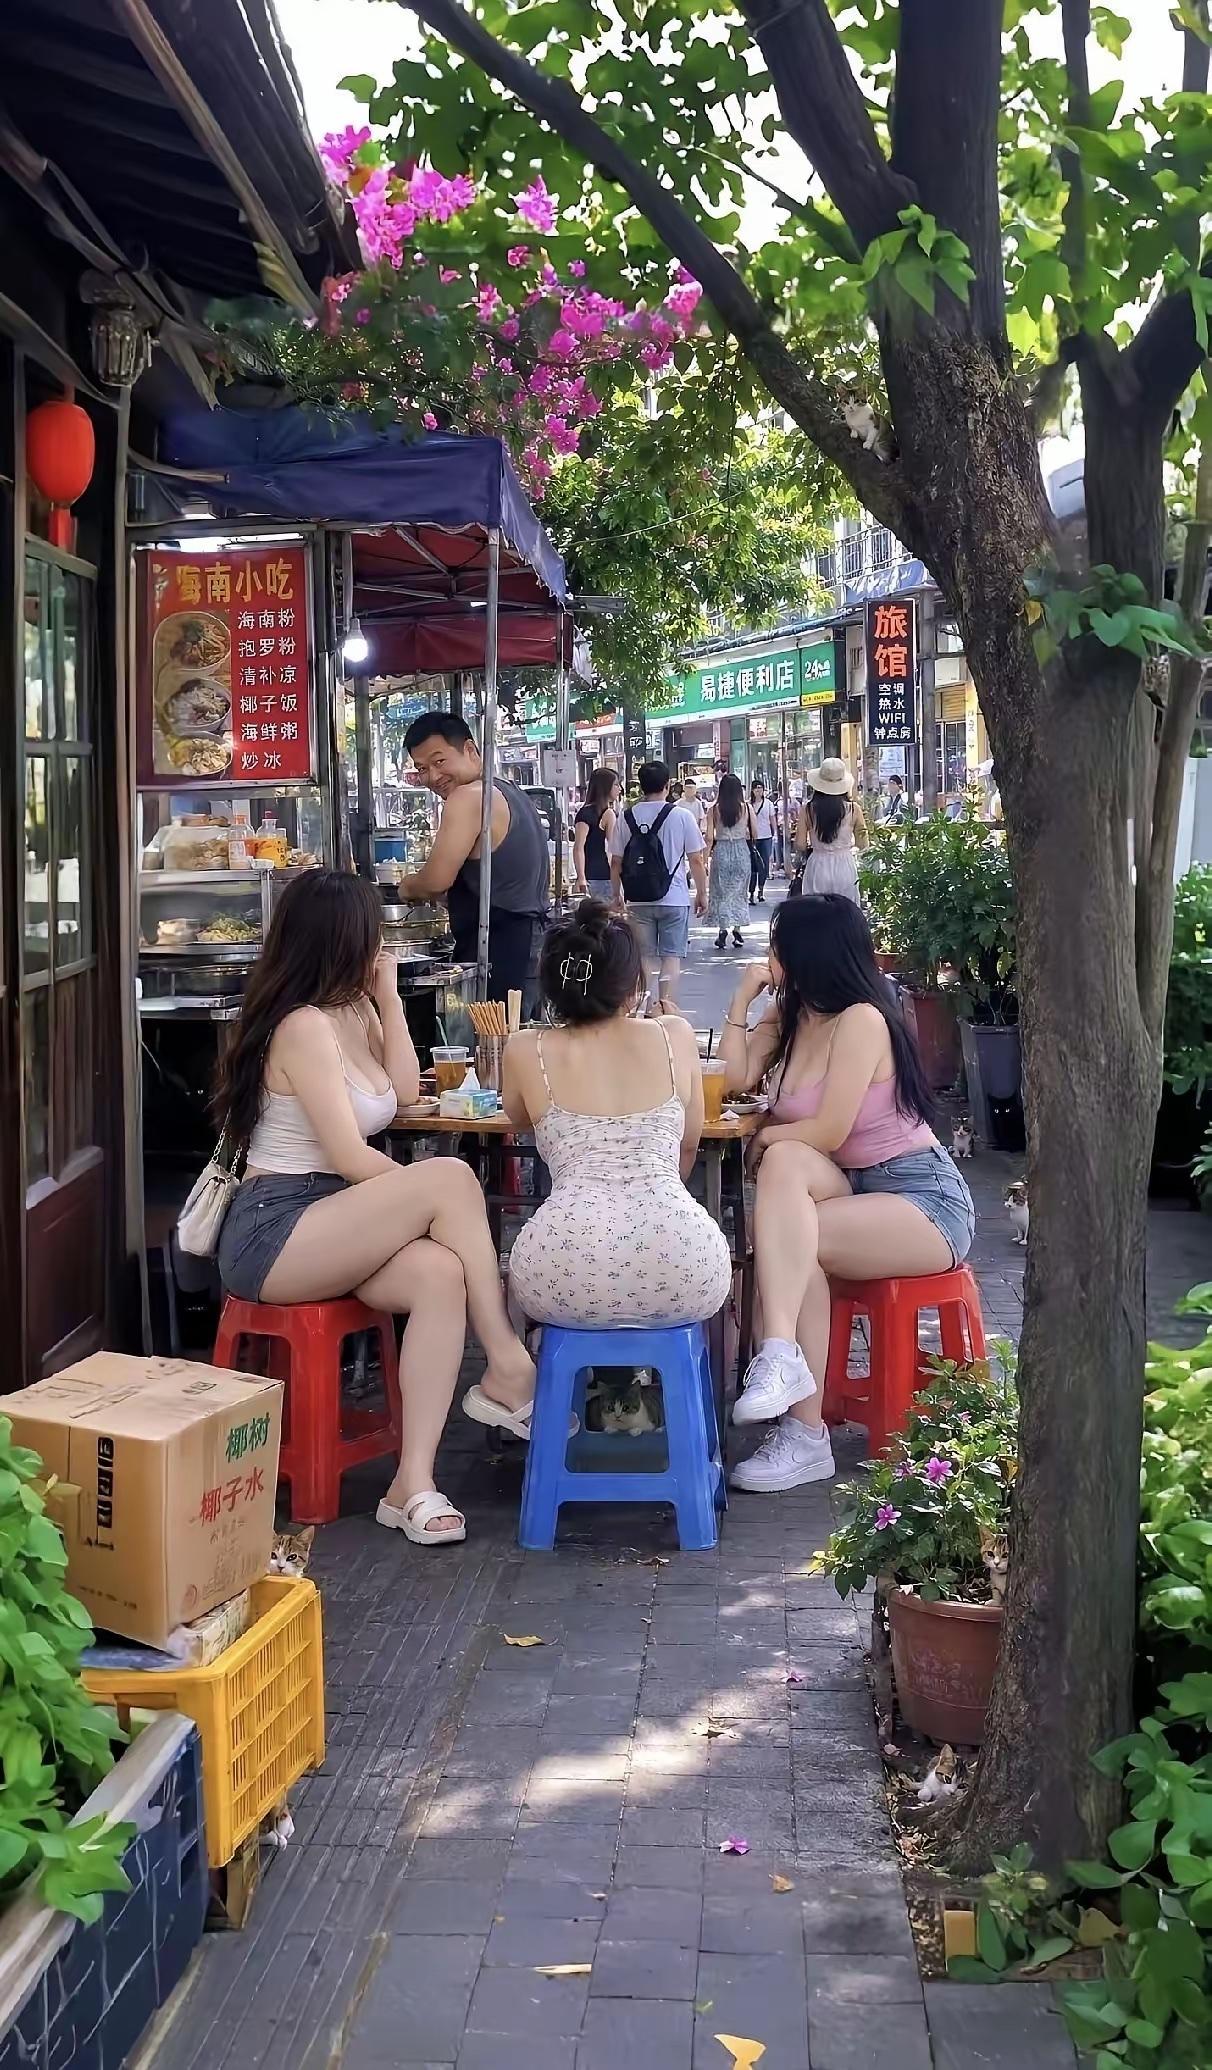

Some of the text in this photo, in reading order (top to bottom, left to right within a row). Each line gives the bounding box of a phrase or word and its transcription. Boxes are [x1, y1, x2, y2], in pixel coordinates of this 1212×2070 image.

[237, 608, 295, 629] 海南粉
[874, 605, 907, 677] 旅馆
[239, 665, 297, 686] 清补凉
[701, 660, 795, 703] 易捷便利店
[240, 693, 298, 714] 椰子饭
[878, 697, 905, 710] 热水
[878, 712, 906, 724] WIFI
[241, 722, 298, 742] 海鲜粥
[873, 727, 911, 740] 钟点房
[241, 751, 281, 769] 炒冰
[225, 1412, 271, 1463] 椰树
[200, 1466, 265, 1527] 椰子水
